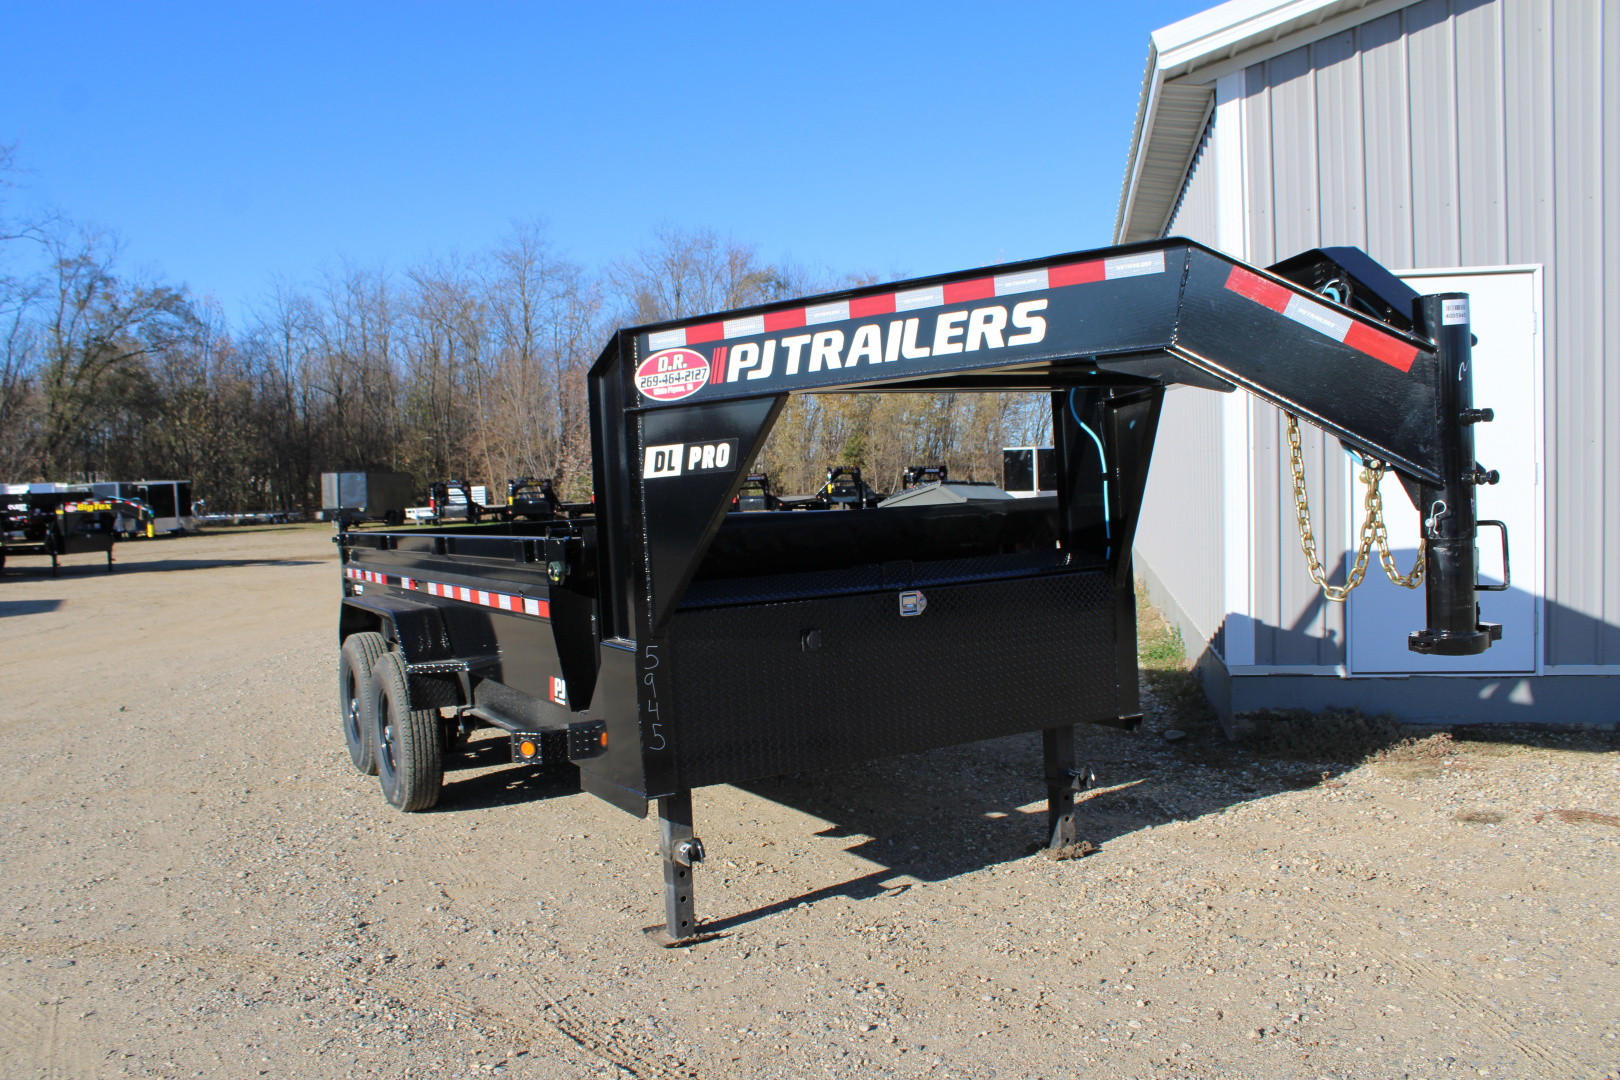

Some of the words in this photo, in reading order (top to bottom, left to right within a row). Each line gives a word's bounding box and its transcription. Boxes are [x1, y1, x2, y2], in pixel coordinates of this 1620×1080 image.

[727, 339, 776, 383] PJ
[781, 299, 1048, 375] TRAILERS
[658, 353, 688, 373] D.R.
[640, 367, 707, 388] 269-464-2127
[654, 449, 676, 473] DL
[688, 443, 730, 471] PRO
[554, 677, 566, 700] PJ
